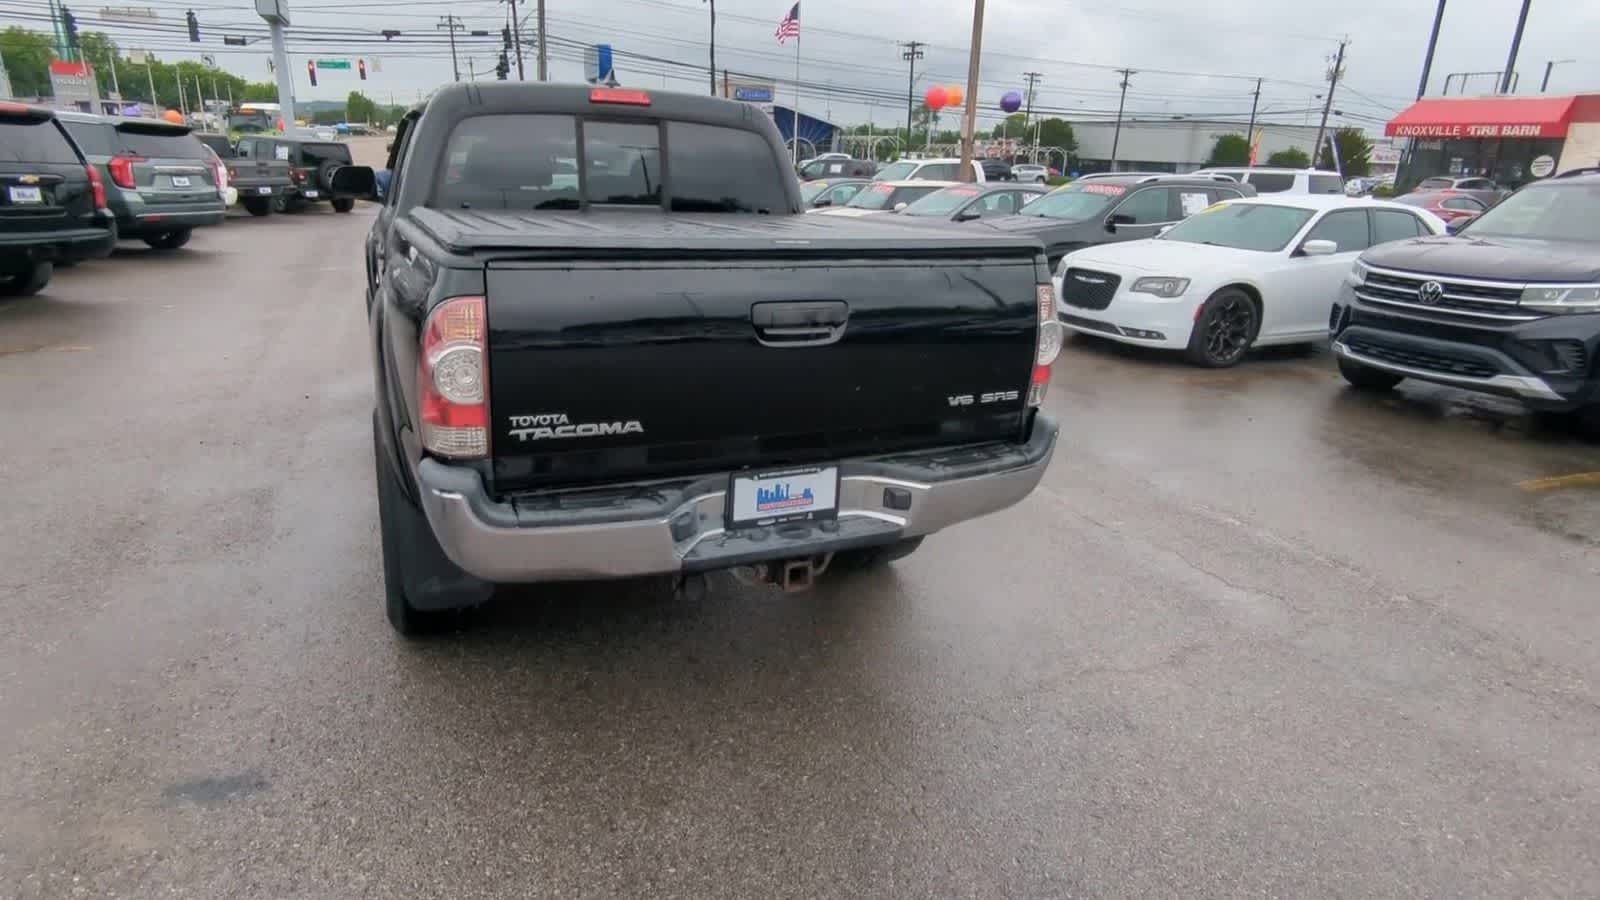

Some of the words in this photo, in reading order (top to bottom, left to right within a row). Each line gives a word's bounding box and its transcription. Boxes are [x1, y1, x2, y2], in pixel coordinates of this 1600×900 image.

[1395, 125, 1461, 136] KNOXVILLE
[1467, 125, 1498, 136] TIRE
[1501, 125, 1541, 136] BARN
[948, 395, 974, 406] V6
[509, 414, 569, 427] TOYOTA
[509, 421, 644, 441] TACOMA
